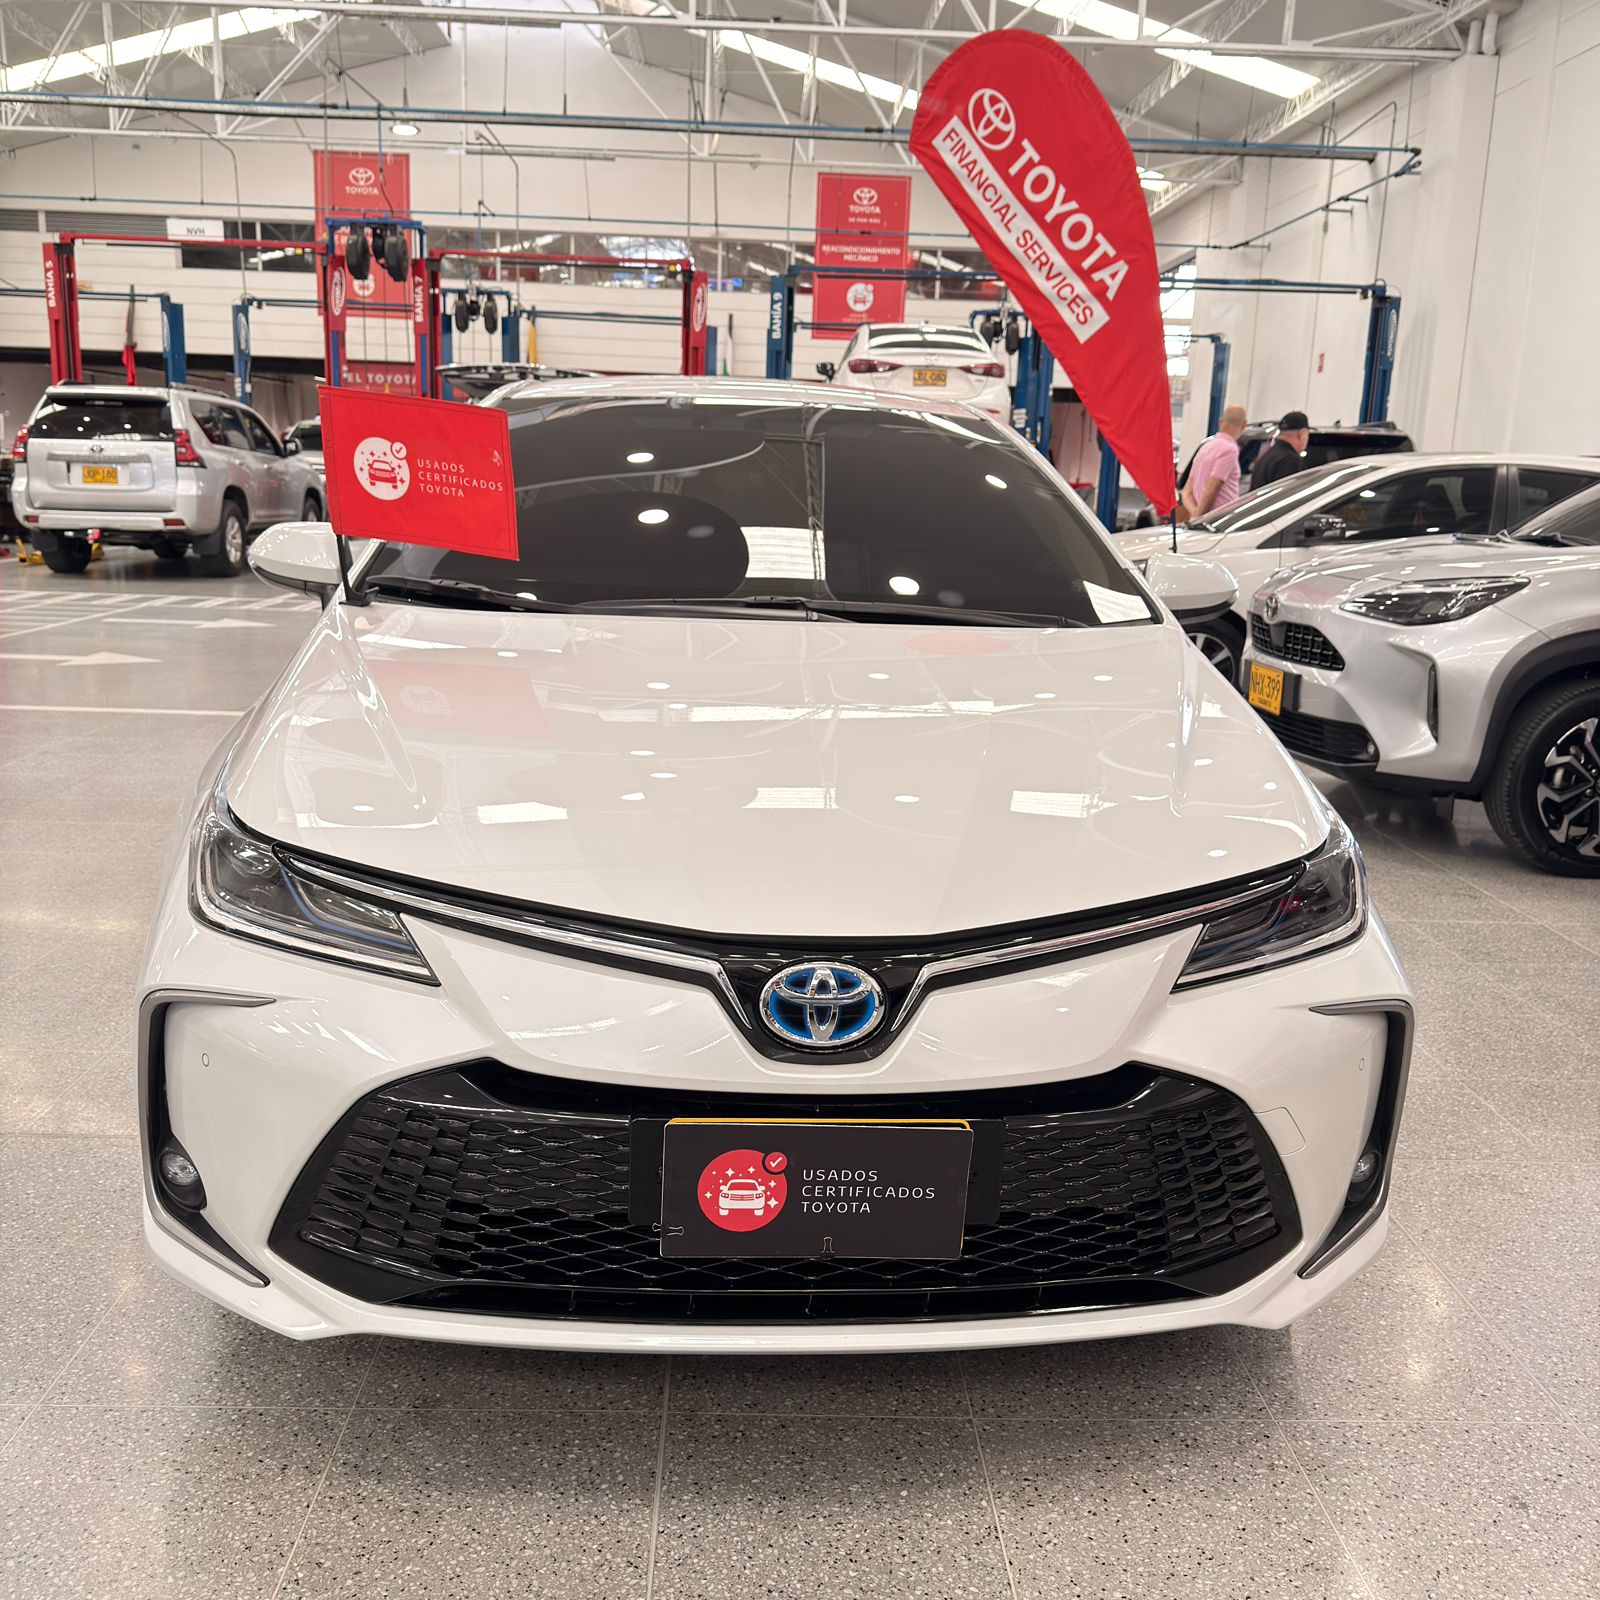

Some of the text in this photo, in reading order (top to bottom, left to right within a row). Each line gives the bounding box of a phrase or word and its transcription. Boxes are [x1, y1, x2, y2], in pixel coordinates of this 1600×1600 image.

[344, 185, 379, 195] TOYOTA
[849, 205, 881, 214] TOYOTA
[942, 128, 1094, 326] FINANCIAL SERVICES
[1008, 138, 1130, 302] TOYOTA
[186, 227, 205, 235] NVH
[771, 292, 783, 340] BAHÍA 9
[417, 458, 465, 473] USADOS
[418, 471, 503, 492] CERTIFICADOS
[419, 483, 465, 498] TOYOTA
[802, 1169, 879, 1183] USADOS
[801, 1185, 936, 1200] CERTIFICADOS
[801, 1201, 871, 1214] TOYOTA
